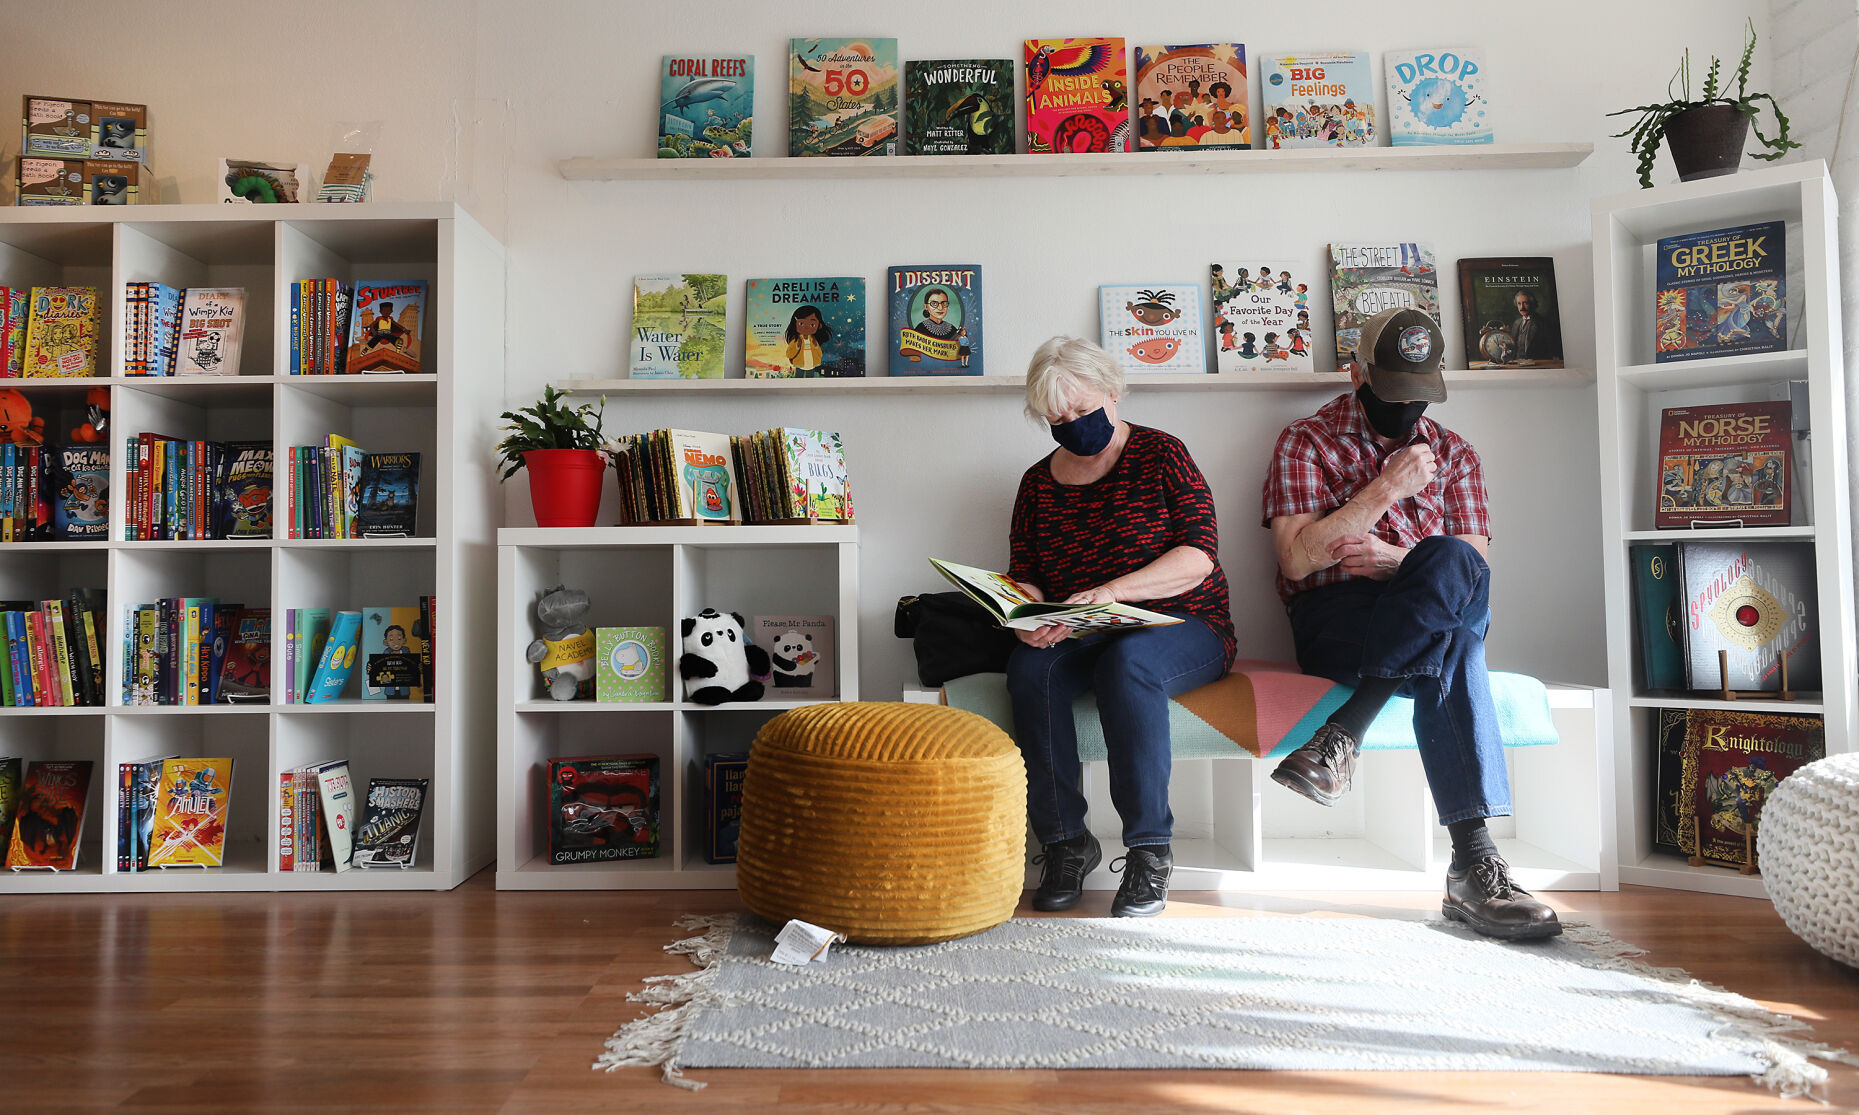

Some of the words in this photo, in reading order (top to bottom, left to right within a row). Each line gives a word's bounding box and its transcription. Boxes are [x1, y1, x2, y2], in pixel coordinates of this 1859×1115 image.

[816, 54, 826, 62] 50
[828, 54, 875, 62] Adventures
[670, 59, 708, 76] CORAL
[712, 59, 746, 77] REEFS
[1168, 64, 1215, 74] PEOPLE
[1290, 68, 1325, 80] BIG
[1395, 53, 1478, 84] DROP
[824, 69, 869, 96] 50
[924, 68, 997, 85] WONDERFUL
[1048, 75, 1100, 92] INSIDE
[1156, 72, 1228, 84] REMEMBER
[1291, 81, 1346, 96] Feelings
[826, 96, 864, 110] States
[1040, 90, 1113, 109] ANIMALS
[940, 144, 968, 152] GONZALEZ
[1697, 236, 1730, 246] TREASURY
[1339, 248, 1358, 267] THE
[1360, 247, 1398, 267] STREET
[1671, 236, 1768, 268] GREEK
[1677, 257, 1762, 278] MYTHOLOGY
[772, 282, 809, 292] ARELI
[814, 282, 825, 291] IS
[830, 282, 840, 290] A
[895, 272, 903, 294] I
[905, 270, 975, 290] DISSENT
[198, 292, 228, 300] DIARY
[357, 285, 422, 309] STUNTBOY
[772, 293, 840, 304] DREAMER
[1251, 295, 1271, 303] Our
[1362, 292, 1410, 313] BENEATH
[12, 298, 29, 318] DO
[189, 308, 217, 318] Wimpy
[220, 304, 234, 316] Kid
[1230, 306, 1272, 315] Favorite
[1275, 306, 1294, 317] Day
[44, 311, 82, 320] diaries
[1261, 317, 1283, 326] Year
[190, 319, 206, 328] BIG
[207, 318, 232, 328] SHOT
[637, 327, 682, 343] Water
[1125, 326, 1154, 336] skin
[902, 331, 916, 340] RUTH
[917, 336, 931, 346] BADER
[932, 341, 956, 350] GINSBURG
[906, 340, 922, 349] MAKES
[922, 344, 932, 354] HER
[640, 347, 652, 362] Is
[658, 346, 704, 362] Water
[1678, 415, 1771, 438] NORSE
[1683, 434, 1765, 446] MYTHOLOGY
[63, 451, 88, 466] DOG
[90, 451, 110, 464] MAN
[237, 450, 273, 462] MAX
[371, 455, 412, 468] WARRIORS
[685, 453, 726, 466] NEMO
[230, 460, 273, 474] MEOW
[808, 463, 834, 479] BUGS
[67, 523, 84, 533] DAV
[1691, 552, 1747, 630] SPYOLOGY
[240, 618, 271, 634] HIL
[421, 640, 430, 651] NEW
[558, 640, 586, 652] NAVEL
[600, 640, 613, 666] BELLY
[613, 631, 648, 642] BUTTON
[36, 645, 45, 670] allergic
[201, 646, 210, 660] HEY,
[319, 646, 332, 669] Sisters
[555, 647, 593, 661] ACADEMY
[201, 661, 209, 682] KIDDO
[324, 677, 344, 688] Sisters
[610, 690, 632, 698] Sandra
[1703, 724, 1803, 759] Knightology
[375, 786, 421, 798] HISTORY
[164, 796, 217, 819] AMULET
[368, 797, 421, 810] SMASHERS
[365, 809, 410, 838] TITANIC
[556, 849, 596, 861] GRUMPY
[600, 847, 640, 858] MONKEY
